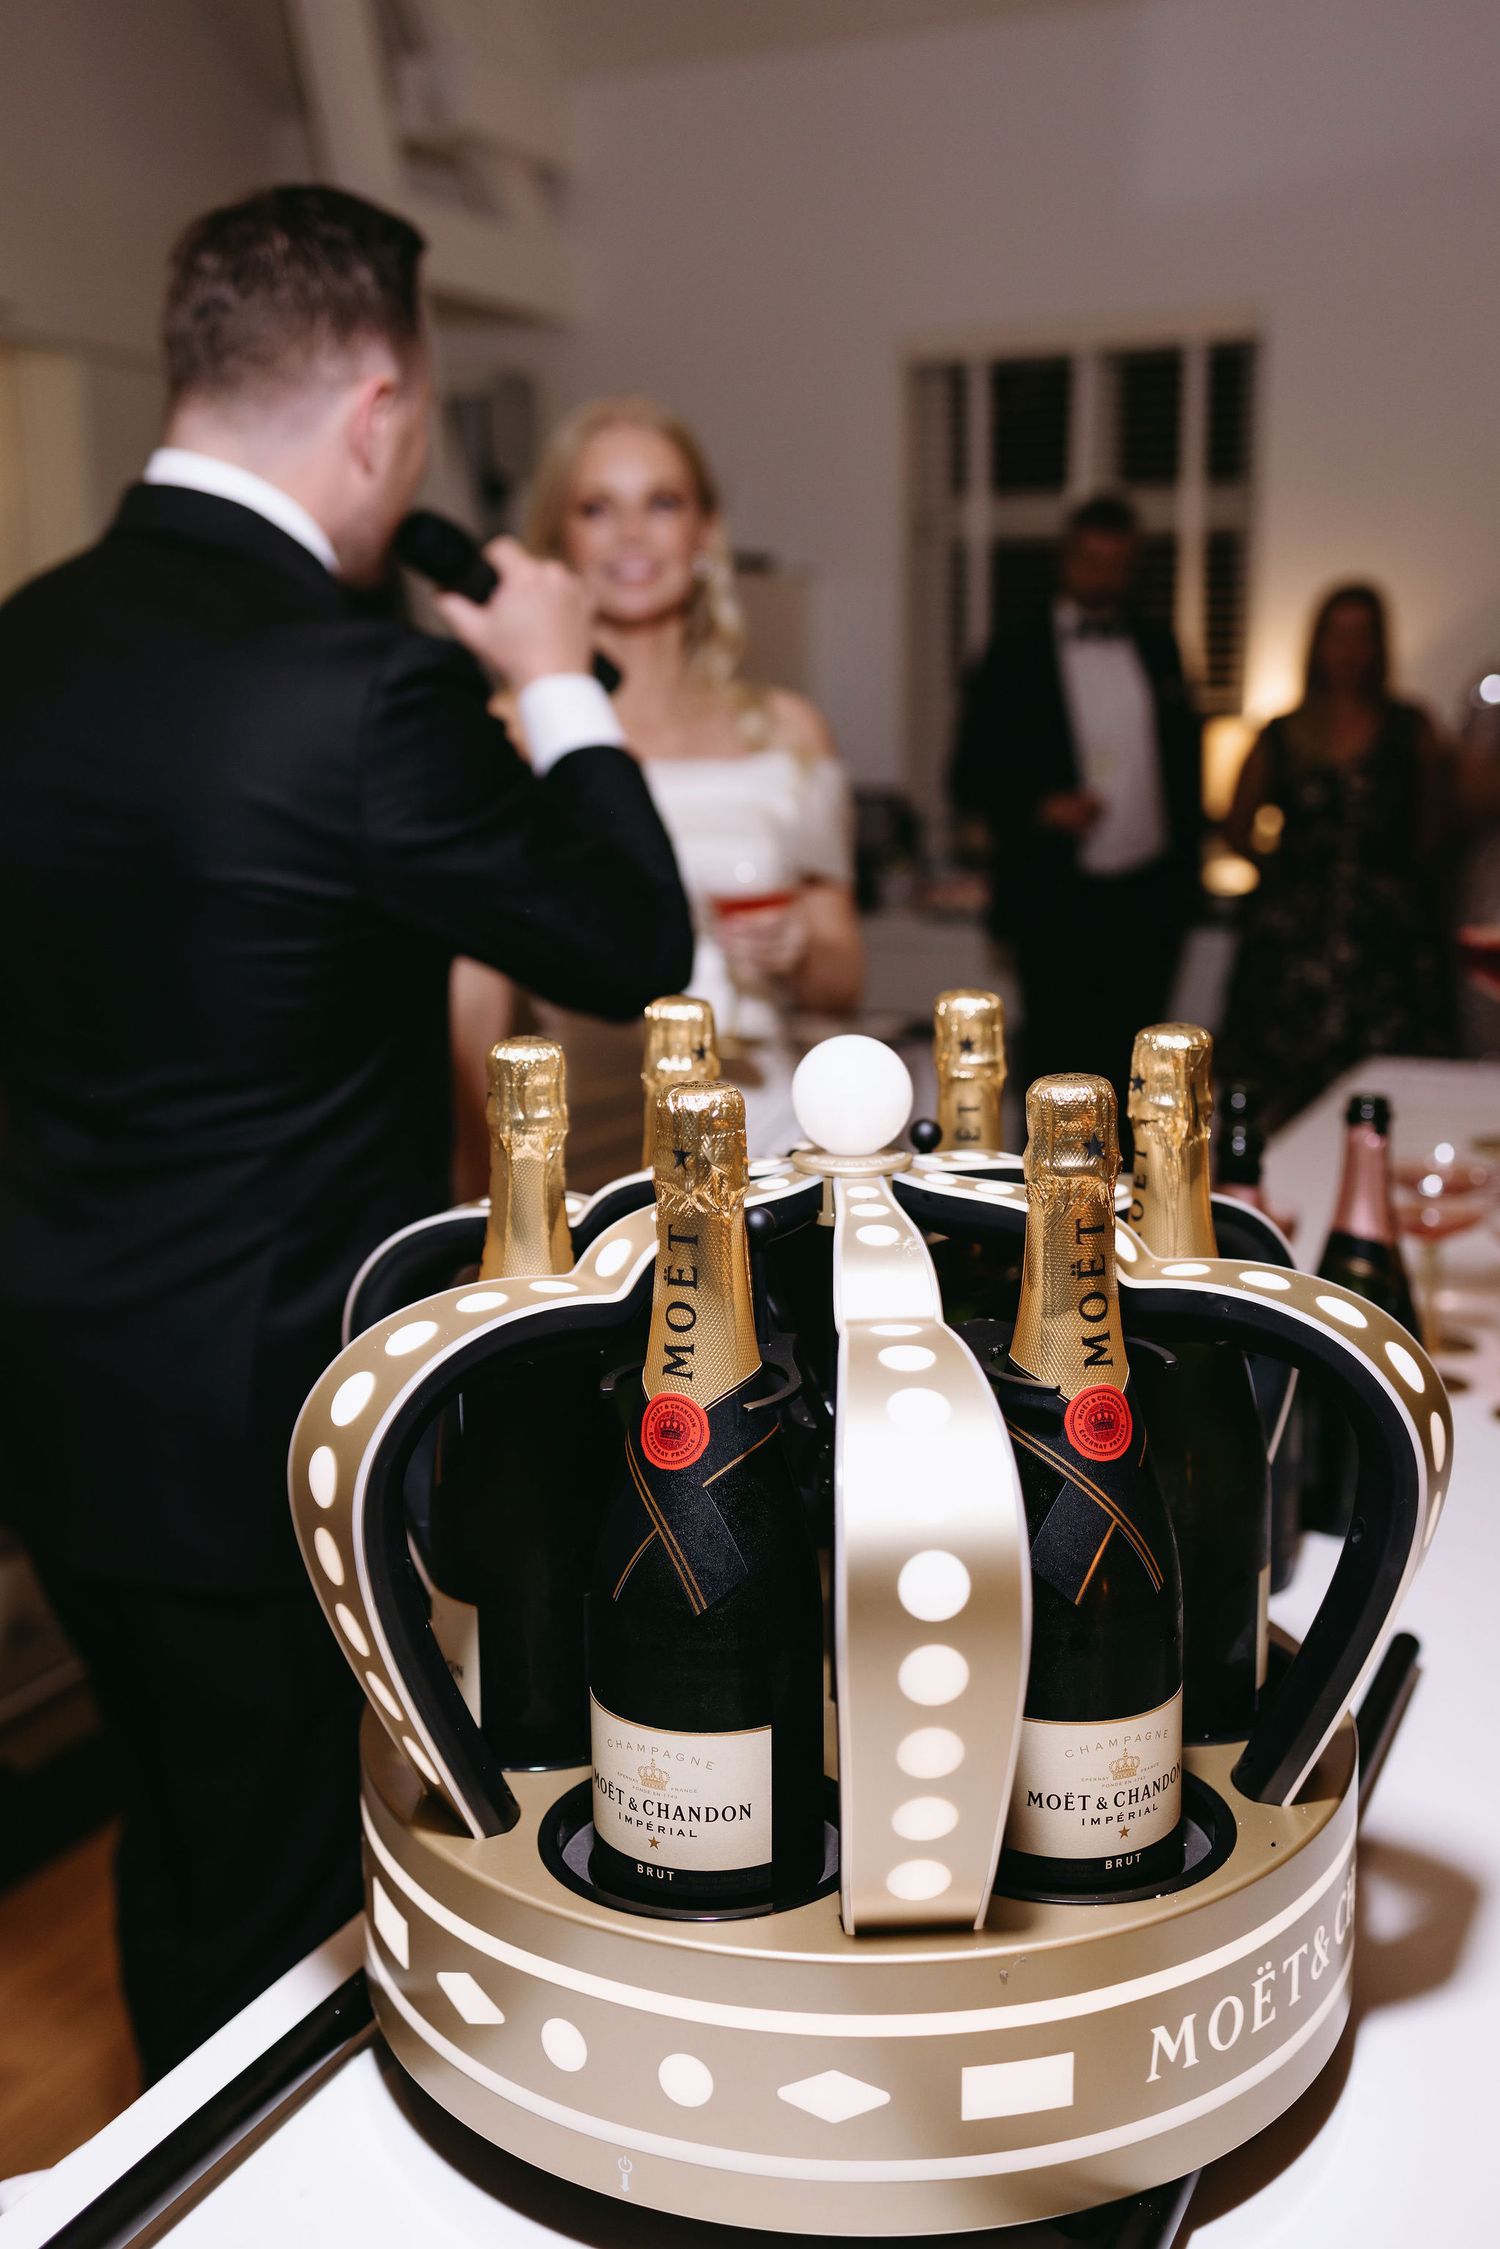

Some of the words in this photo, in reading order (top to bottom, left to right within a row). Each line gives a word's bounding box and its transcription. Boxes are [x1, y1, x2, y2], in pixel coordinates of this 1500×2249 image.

[662, 1223, 698, 1381] MOËT
[1070, 1217, 1114, 1370] MOËT
[607, 1738, 715, 1771] CHAMPAGNE
[1064, 1728, 1169, 1758] CHAMPAGNE
[593, 1767, 625, 1805] MOËT
[628, 1797, 638, 1813] &
[643, 1799, 752, 1823] CHANDON
[1027, 1790, 1091, 1811] MOËT
[1096, 1797, 1108, 1810] &
[618, 1811, 698, 1838] IMPÉRIAL
[1081, 1803, 1159, 1826] IMPÉRIAL
[636, 1863, 675, 1881] BRUT
[1105, 1852, 1142, 1870] BRUT
[1145, 1943, 1309, 2083] MOËT
